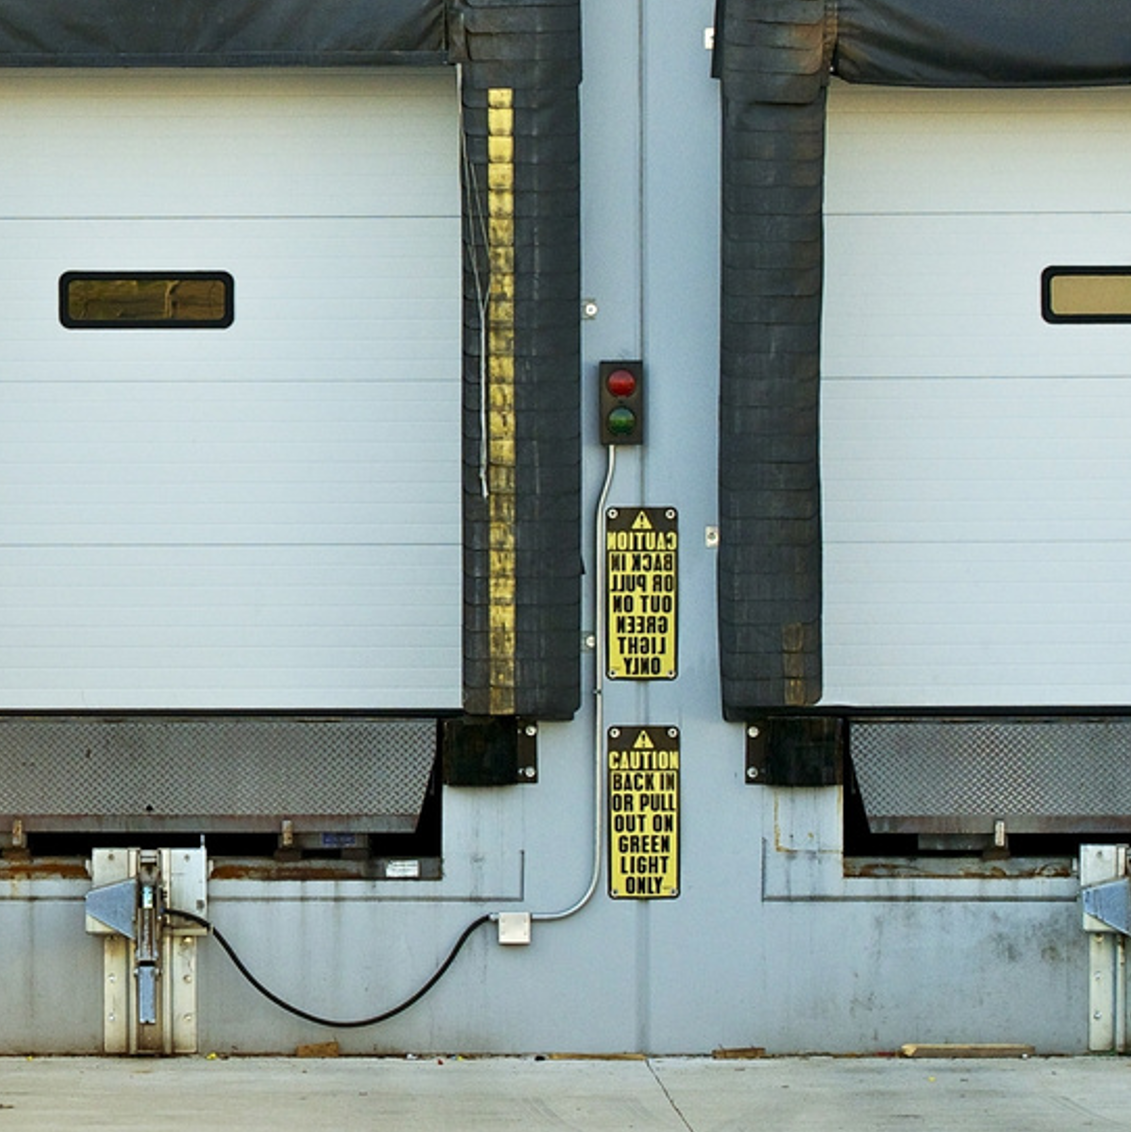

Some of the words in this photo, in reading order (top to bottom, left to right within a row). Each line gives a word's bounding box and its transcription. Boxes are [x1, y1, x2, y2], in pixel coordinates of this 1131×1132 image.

[609, 751, 678, 770] CAUTION
[613, 773, 654, 791] BACK
[660, 773, 674, 791] IN
[612, 794, 633, 812] OR
[640, 794, 676, 812] PULL
[614, 814, 646, 832] OUT
[652, 814, 673, 832] ON
[618, 835, 670, 853] GREEN
[621, 856, 669, 874] LIGHT
[626, 877, 663, 894] ONLY
